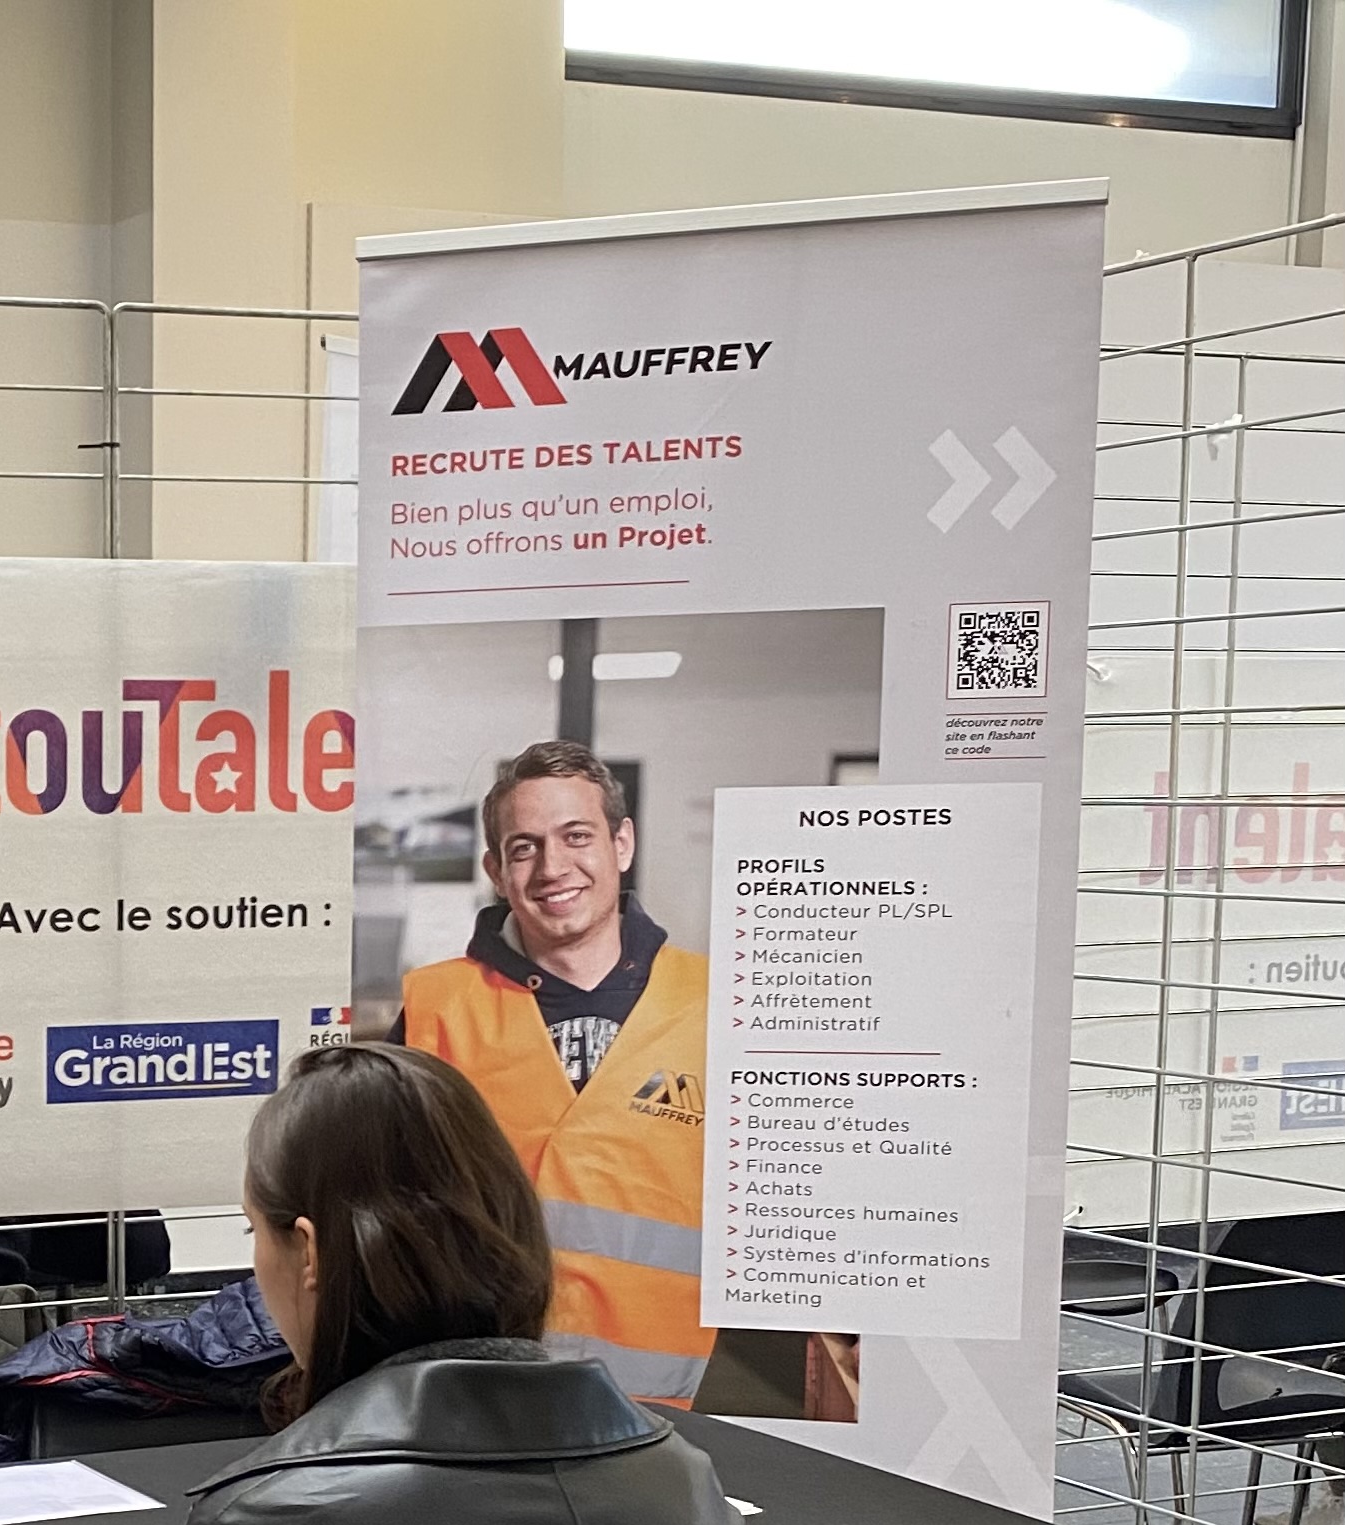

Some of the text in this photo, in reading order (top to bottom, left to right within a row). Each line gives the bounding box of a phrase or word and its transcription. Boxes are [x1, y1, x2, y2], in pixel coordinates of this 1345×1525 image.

[553, 341, 773, 381] MAUFFREY
[391, 436, 742, 476] RECRUTE DES TALENTS
[391, 502, 448, 524] Bien
[458, 498, 512, 525] plus
[609, 487, 713, 516] emploi,
[391, 523, 713, 558] Nous offrons un Projet.
[946, 717, 1044, 728] découvrez notre
[945, 730, 1036, 741] site en flashant
[945, 744, 992, 754] ce code
[799, 809, 952, 827] NOS POSTES
[737, 859, 825, 874] PROFILS
[736, 877, 915, 896] OPÉRATIONNELS
[116, 899, 151, 932] le
[166, 896, 308, 931] soutien
[753, 902, 953, 920] Conducteur PL/SPL
[753, 927, 858, 942] Formateur
[752, 949, 863, 964] Mécanicien
[752, 971, 872, 988] Exploitation
[751, 993, 872, 1009] Affrètement
[750, 1015, 881, 1032] Administratif
[93, 1032, 183, 1051] La Région
[310, 1030, 349, 1048] RÉGI
[731, 1071, 850, 1087] FONCTIONS
[856, 1073, 966, 1089] SUPPORTS
[748, 1093, 854, 1109] Commerce
[628, 1101, 704, 1127] MAUFFREY
[747, 1115, 816, 1131] Bureau
[747, 1137, 952, 1156] Processus et Qualité
[746, 1159, 823, 1175] Finance
[745, 1181, 813, 1197] Achats
[745, 1203, 959, 1223] Ressources humaines
[744, 1225, 836, 1243] Juridique
[743, 1246, 836, 1264] Systèmes
[743, 1268, 926, 1289] Communication et
[725, 1288, 822, 1308] Marketing
